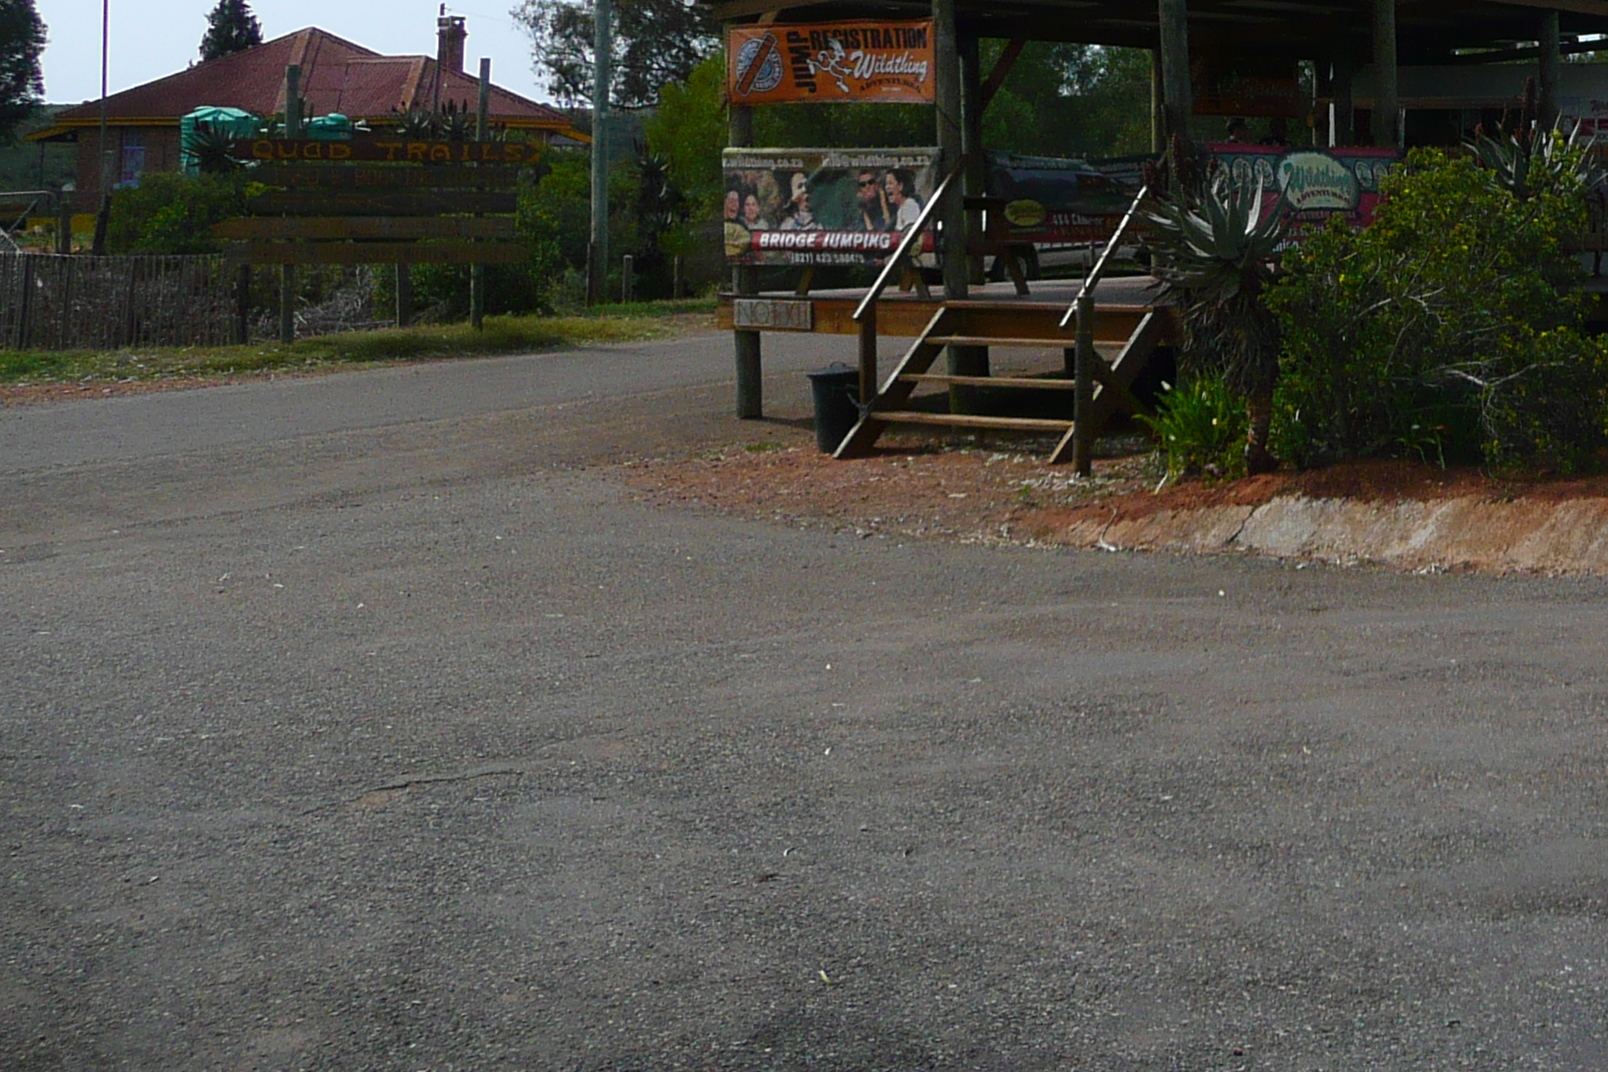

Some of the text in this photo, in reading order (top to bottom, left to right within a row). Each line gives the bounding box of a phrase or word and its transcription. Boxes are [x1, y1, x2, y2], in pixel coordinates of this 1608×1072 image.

[809, 27, 928, 51] REGISTRATION
[786, 30, 818, 94] JUMP
[849, 49, 928, 82] Wildthing
[251, 139, 524, 163] QUAD TRAILS
[759, 232, 896, 249] BRIDGE JUMPING
[737, 301, 770, 326] NO
